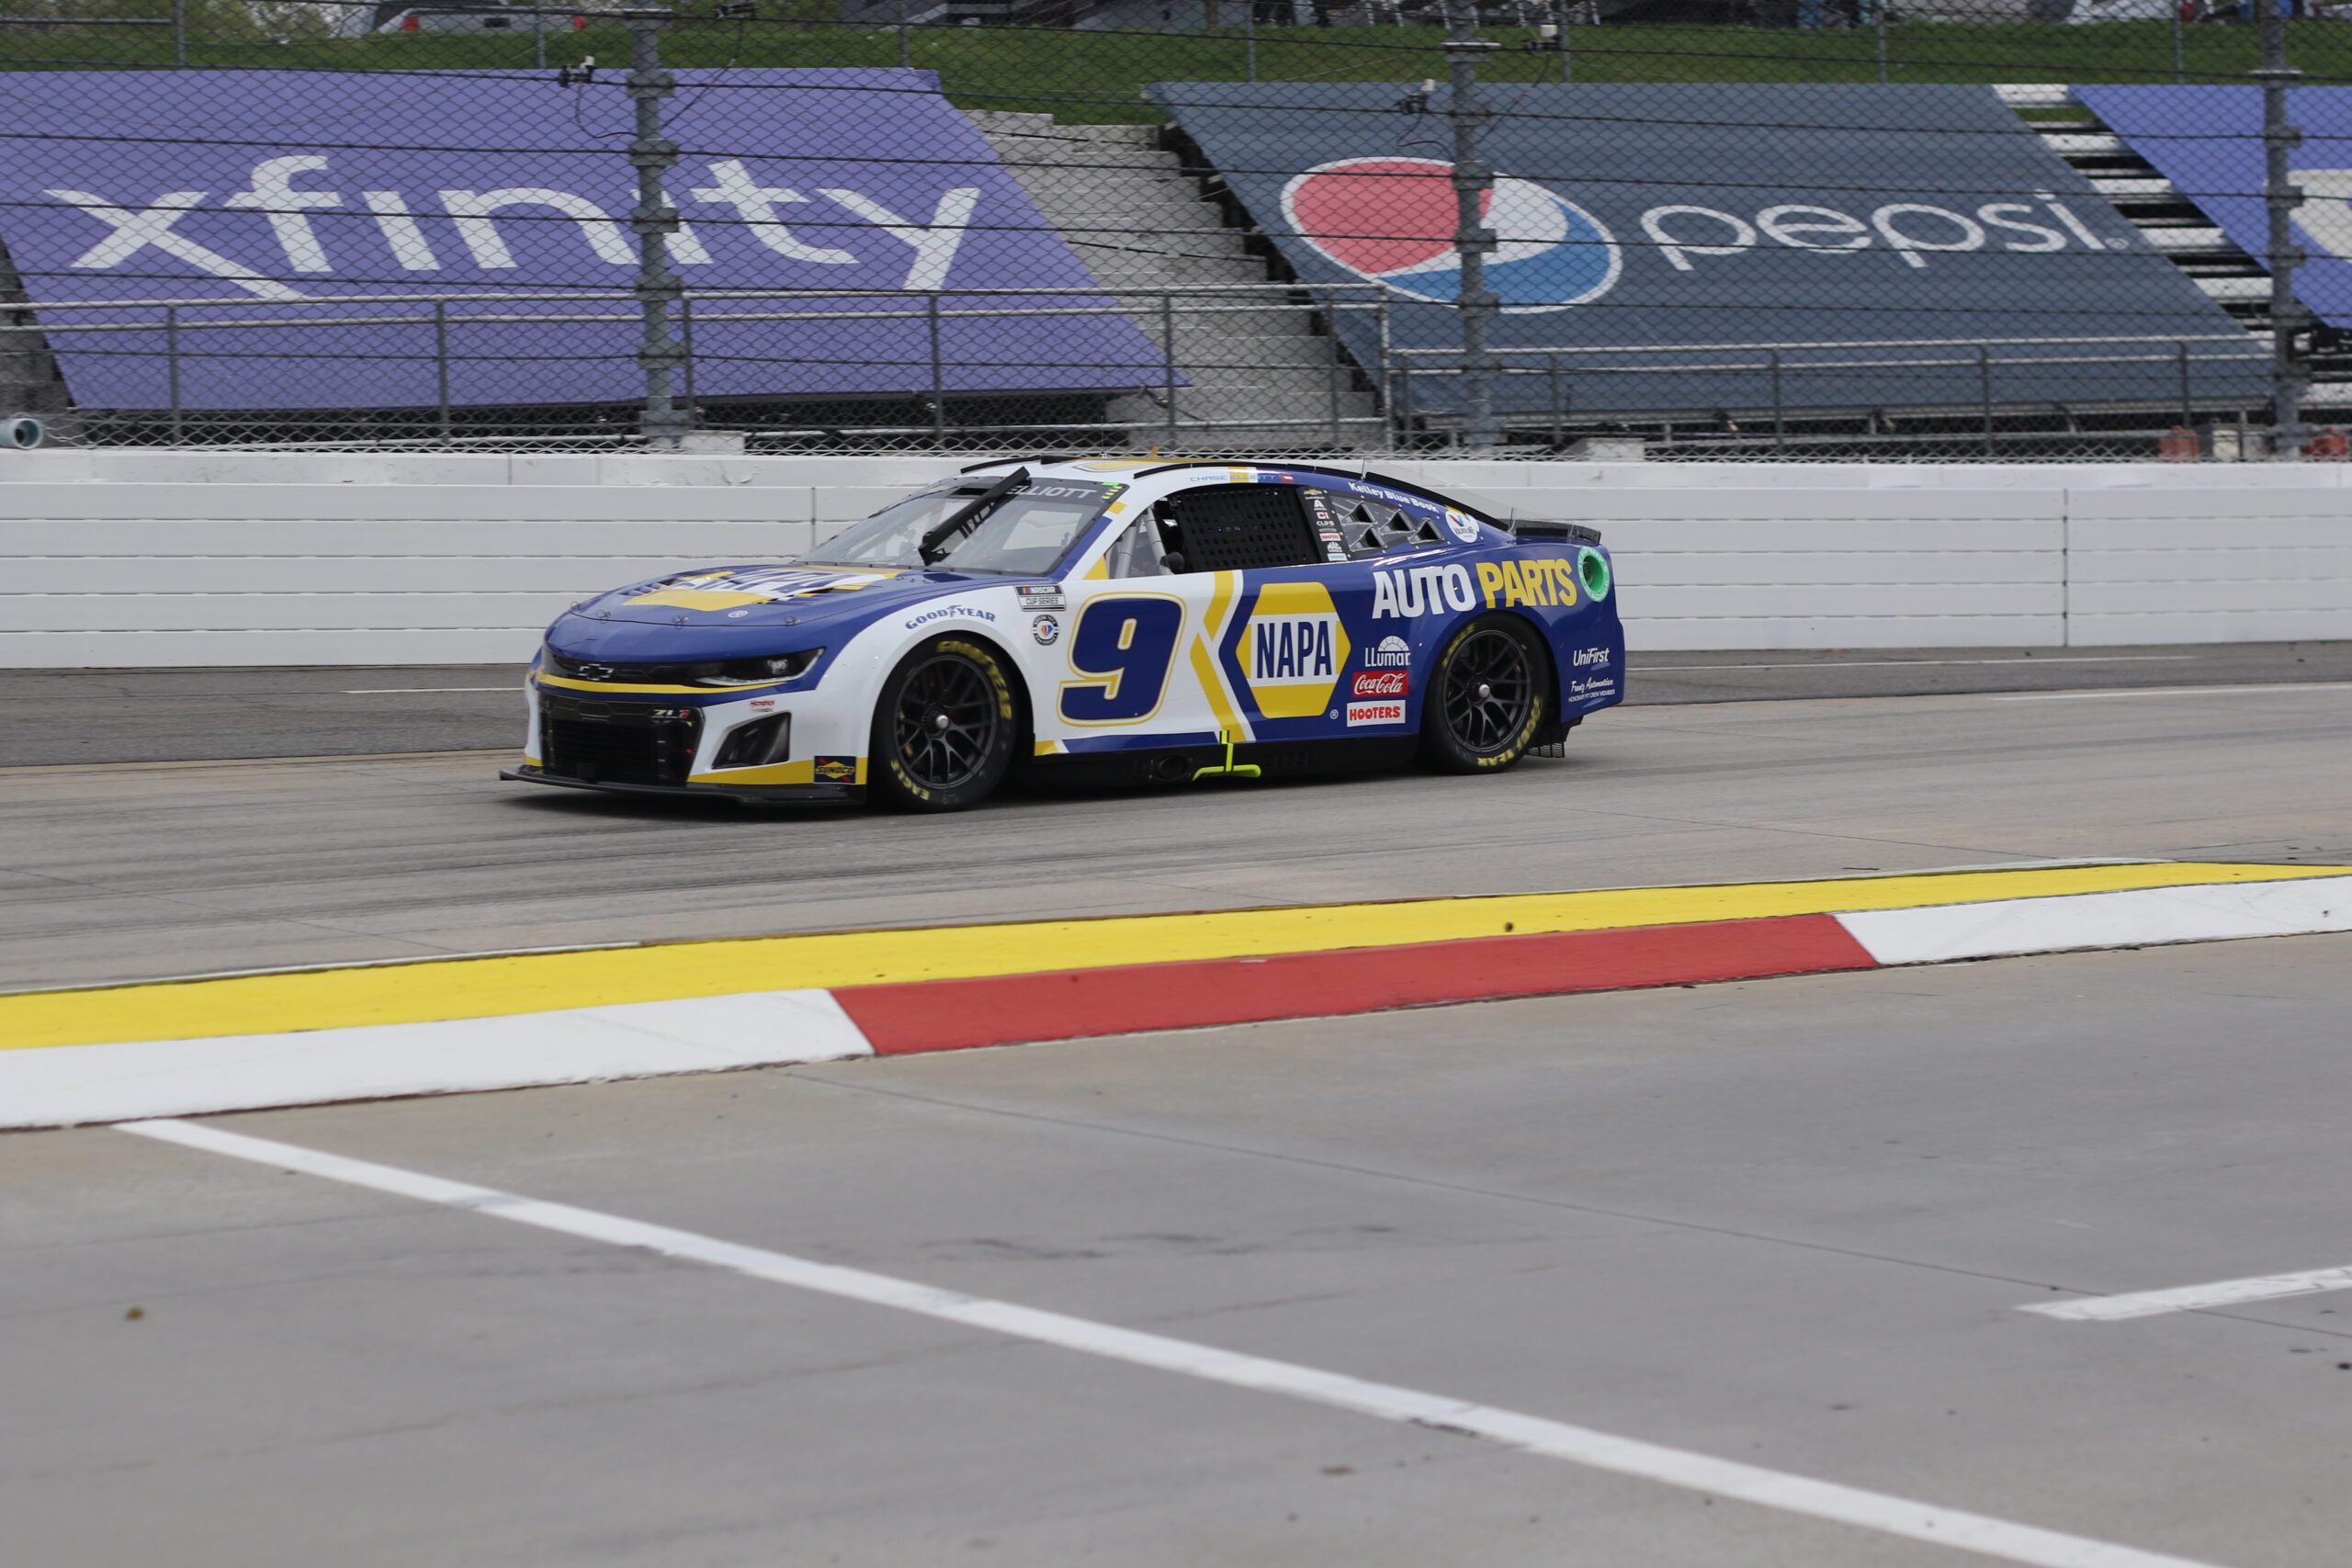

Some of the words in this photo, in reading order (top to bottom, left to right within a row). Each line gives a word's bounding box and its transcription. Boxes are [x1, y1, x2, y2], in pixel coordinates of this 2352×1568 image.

[43, 154, 979, 301] xfinity
[1640, 189, 2107, 272] pepsi
[1006, 485, 1098, 499] ELLIOTT
[1347, 482, 1384, 499] Kelley
[1385, 490, 1411, 504] Blue
[1410, 499, 1440, 513] Book
[1025, 597, 1037, 605] CUP
[1038, 596, 1059, 604] SERIES
[1372, 564, 1476, 619] AUTO
[1476, 558, 1577, 608] PARTS
[905, 604, 997, 630] GOODYEAR
[1057, 592, 1186, 727] 9
[1257, 620, 1332, 679] NAPA
[1573, 648, 1611, 667] UniFirst
[1350, 705, 1401, 721] HOOTERS
[817, 766, 854, 774] SUNOCO
